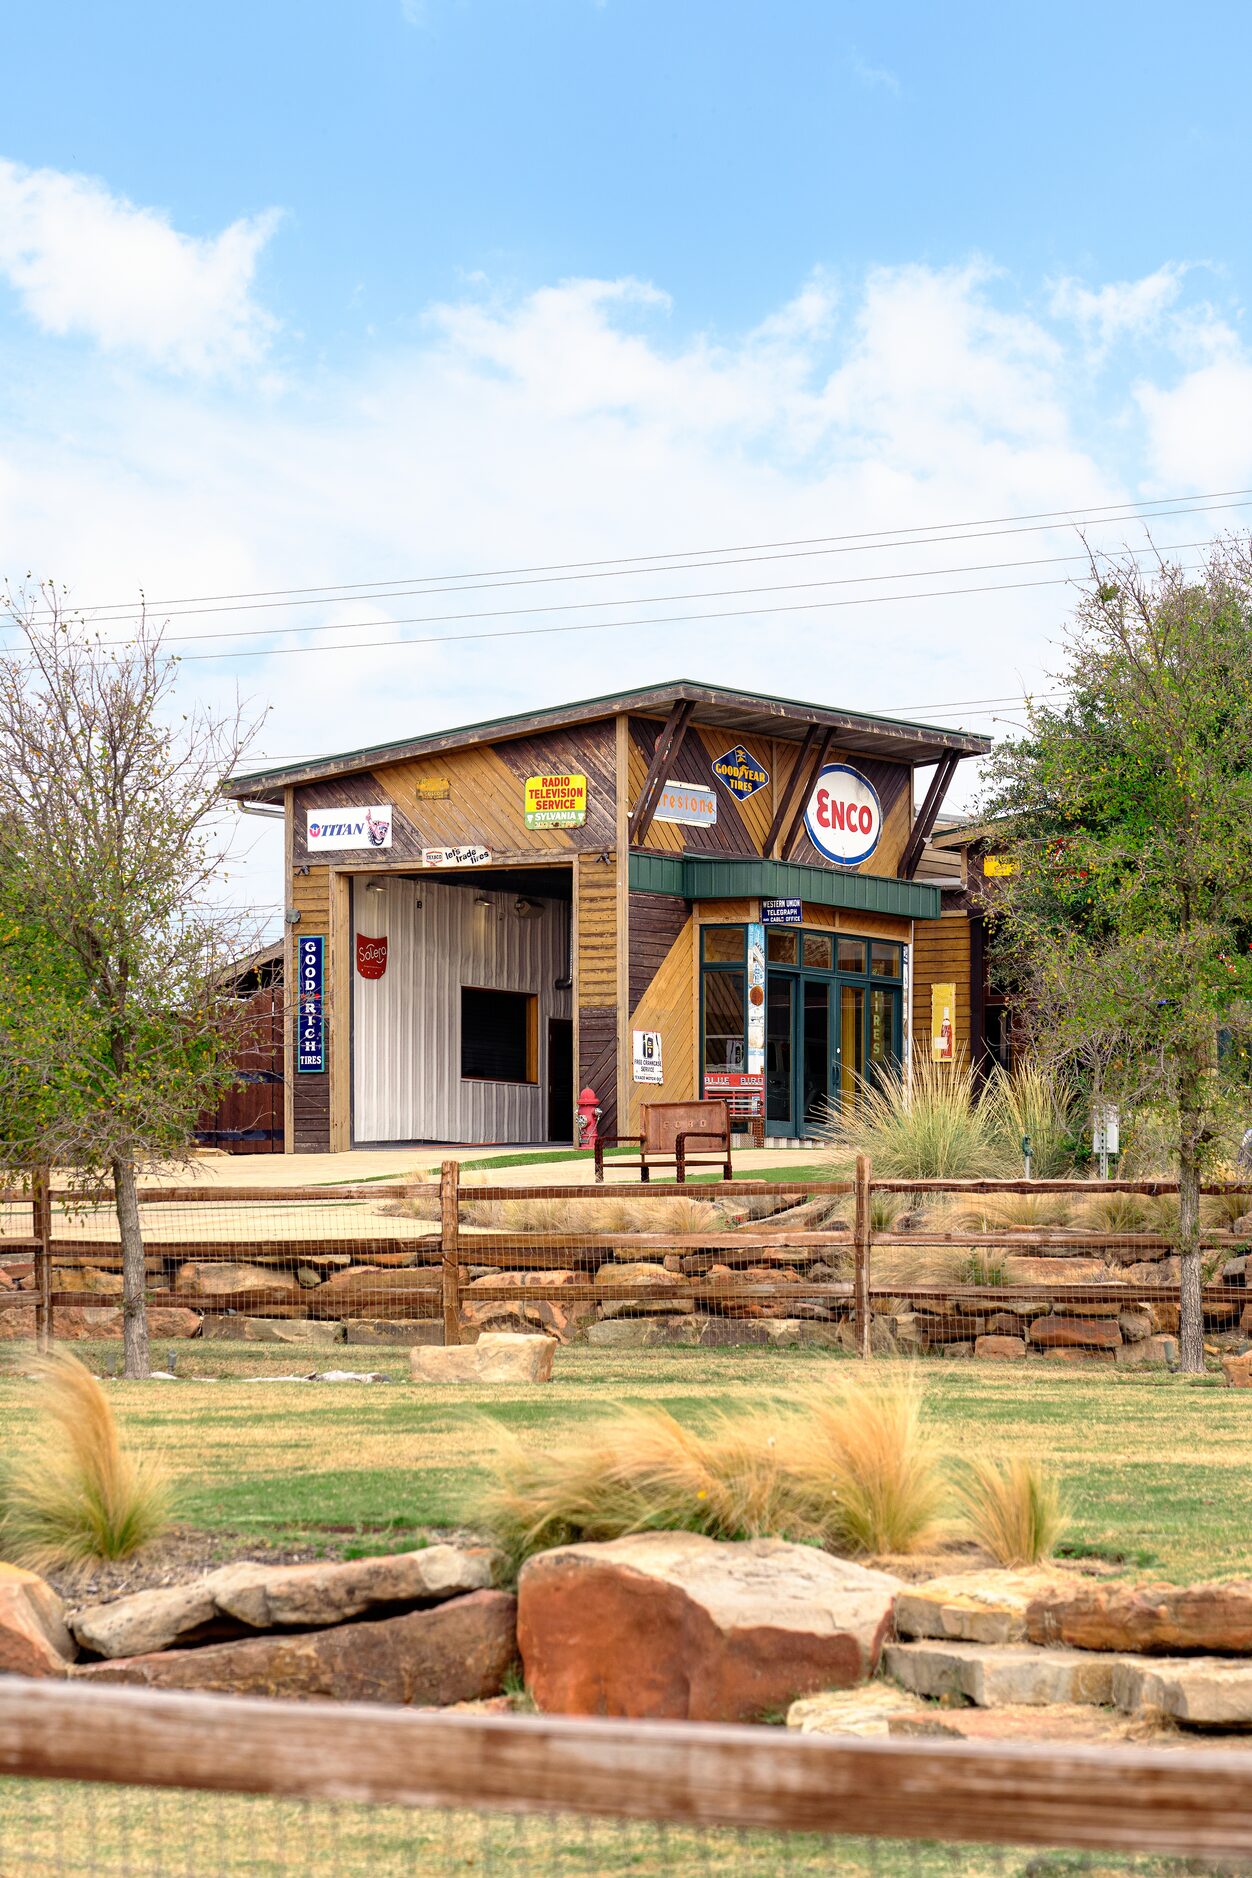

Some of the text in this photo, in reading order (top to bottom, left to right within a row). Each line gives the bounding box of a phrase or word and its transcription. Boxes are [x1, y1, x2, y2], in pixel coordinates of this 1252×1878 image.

[715, 762, 766, 783] GOODYEAR
[541, 776, 571, 788] RADIO
[729, 778, 753, 793] TIRES
[528, 787, 583, 799] TELEVISION
[535, 799, 576, 810] SERVICE
[657, 792, 714, 815] restone
[534, 811, 577, 821] SYLVANIA
[816, 788, 873, 835] ENCO
[321, 822, 365, 837] TITAN
[455, 848, 477, 863] trade
[762, 899, 801, 908] WESTERN UNION
[766, 908, 798, 916] TELEGRAPH
[300, 1055, 322, 1065] TIRES
[704, 1076, 764, 1086] BLUE BIRD
